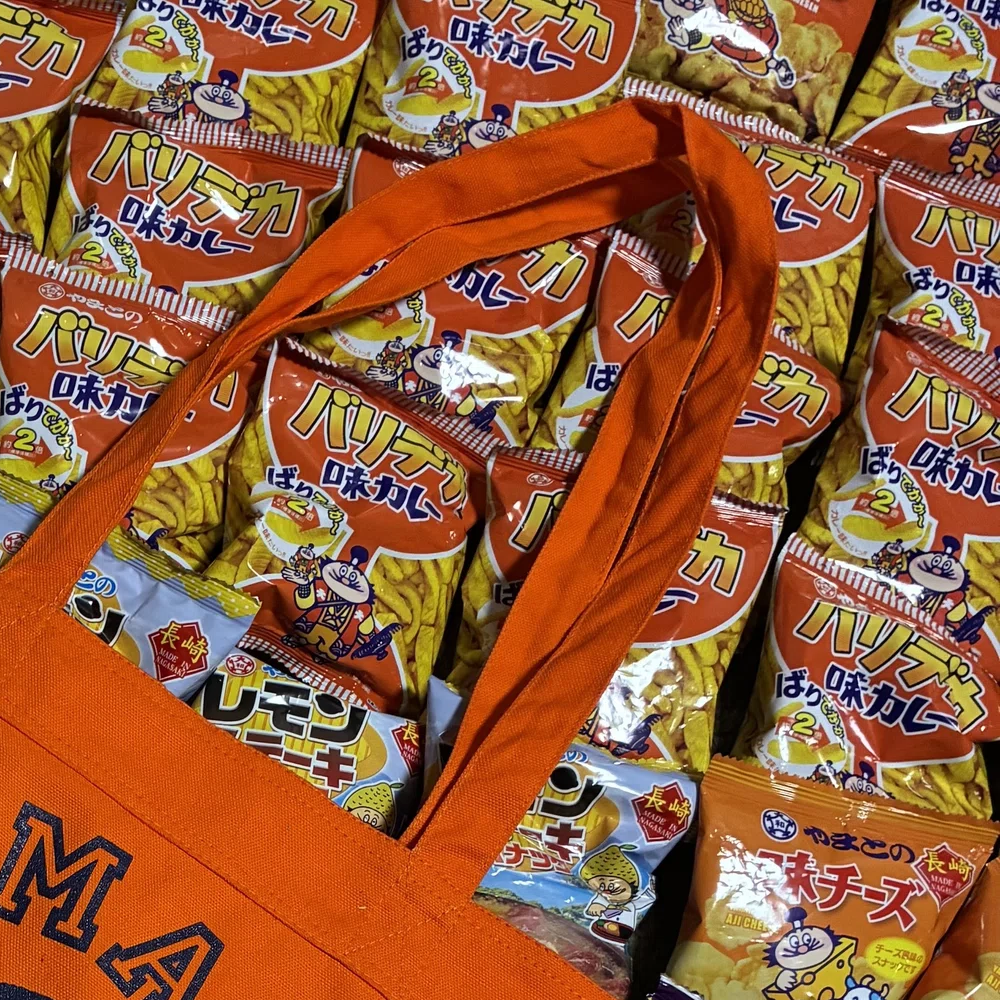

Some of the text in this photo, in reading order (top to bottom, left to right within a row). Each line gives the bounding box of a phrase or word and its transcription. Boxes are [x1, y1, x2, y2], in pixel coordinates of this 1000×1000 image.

[450, 17, 575, 75] 味カレー
[88, 130, 302, 238] バリデカ
[119, 195, 255, 256] 味カレー
[160, 622, 207, 663] 長崎
[203, 670, 371, 746] レモン
[825, 663, 959, 735] 味カレー
[645, 787, 690, 825] 長崎
[803, 825, 916, 864] やまとの
[926, 851, 971, 882] 長崎
